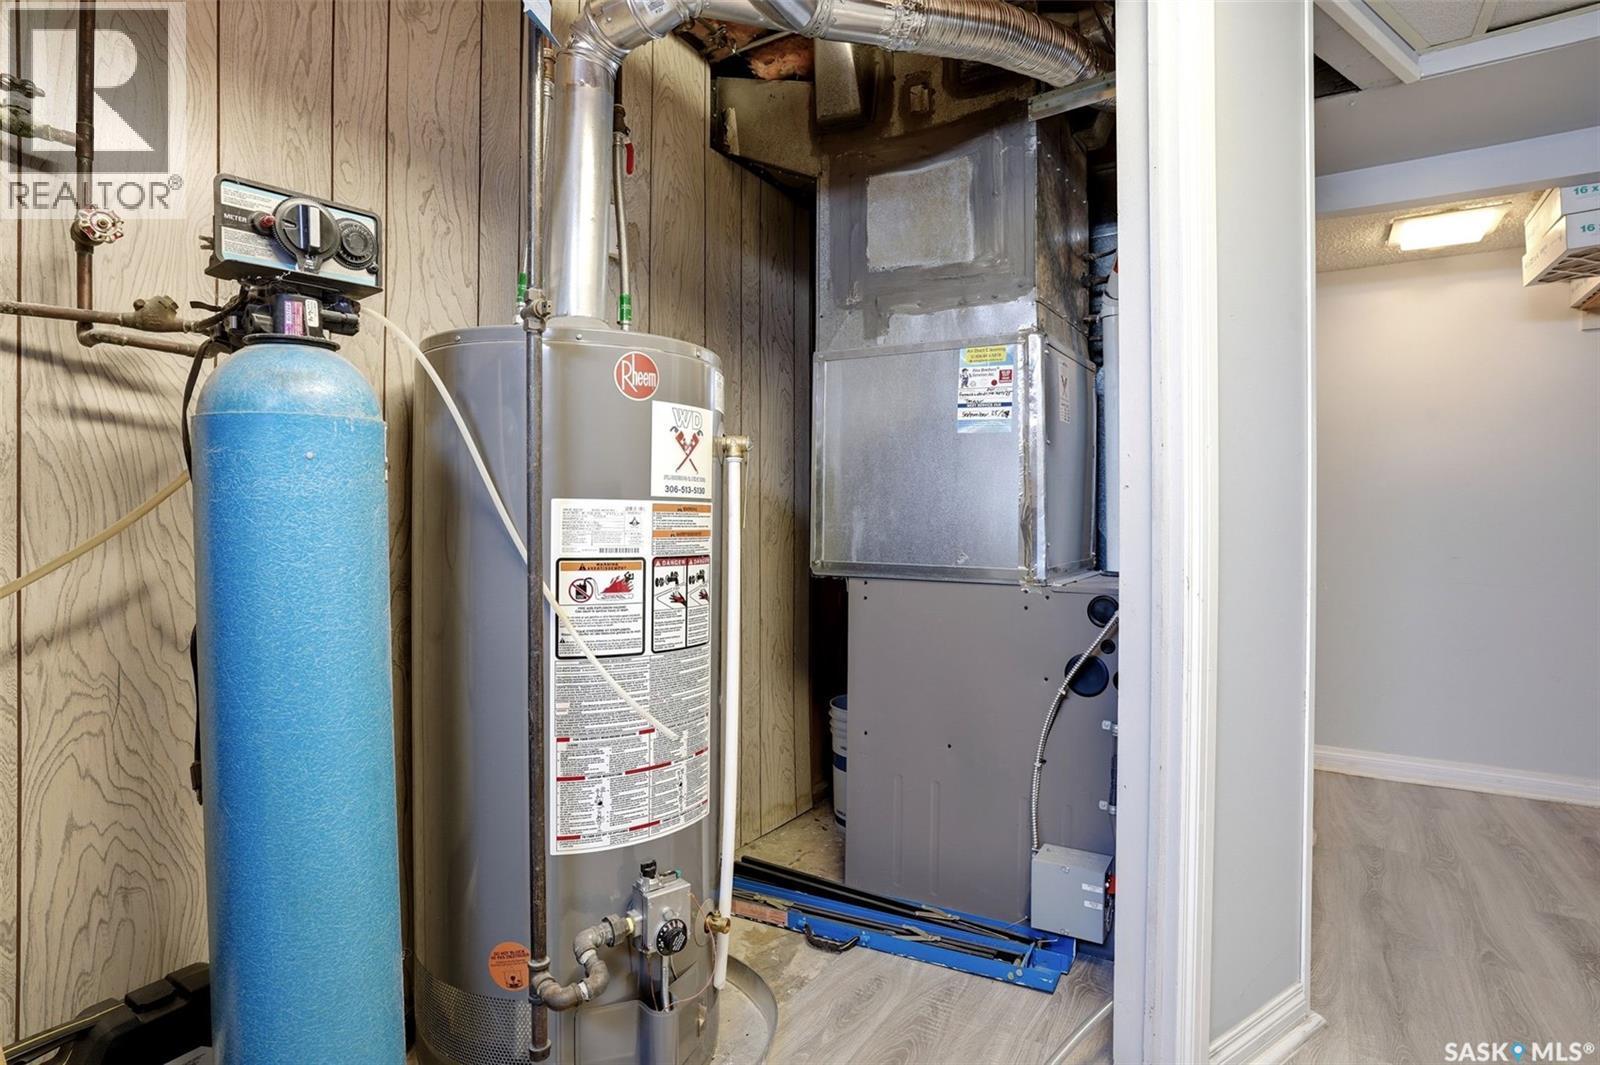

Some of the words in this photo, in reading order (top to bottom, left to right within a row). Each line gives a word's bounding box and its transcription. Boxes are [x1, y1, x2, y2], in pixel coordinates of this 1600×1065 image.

[1574, 186, 1588, 195] 16
[223, 213, 248, 223] METER
[1581, 224, 1595, 232] 16
[621, 354, 657, 392] Rheem
[672, 407, 703, 431] WD
[664, 484, 706, 496] 306-513-5130
